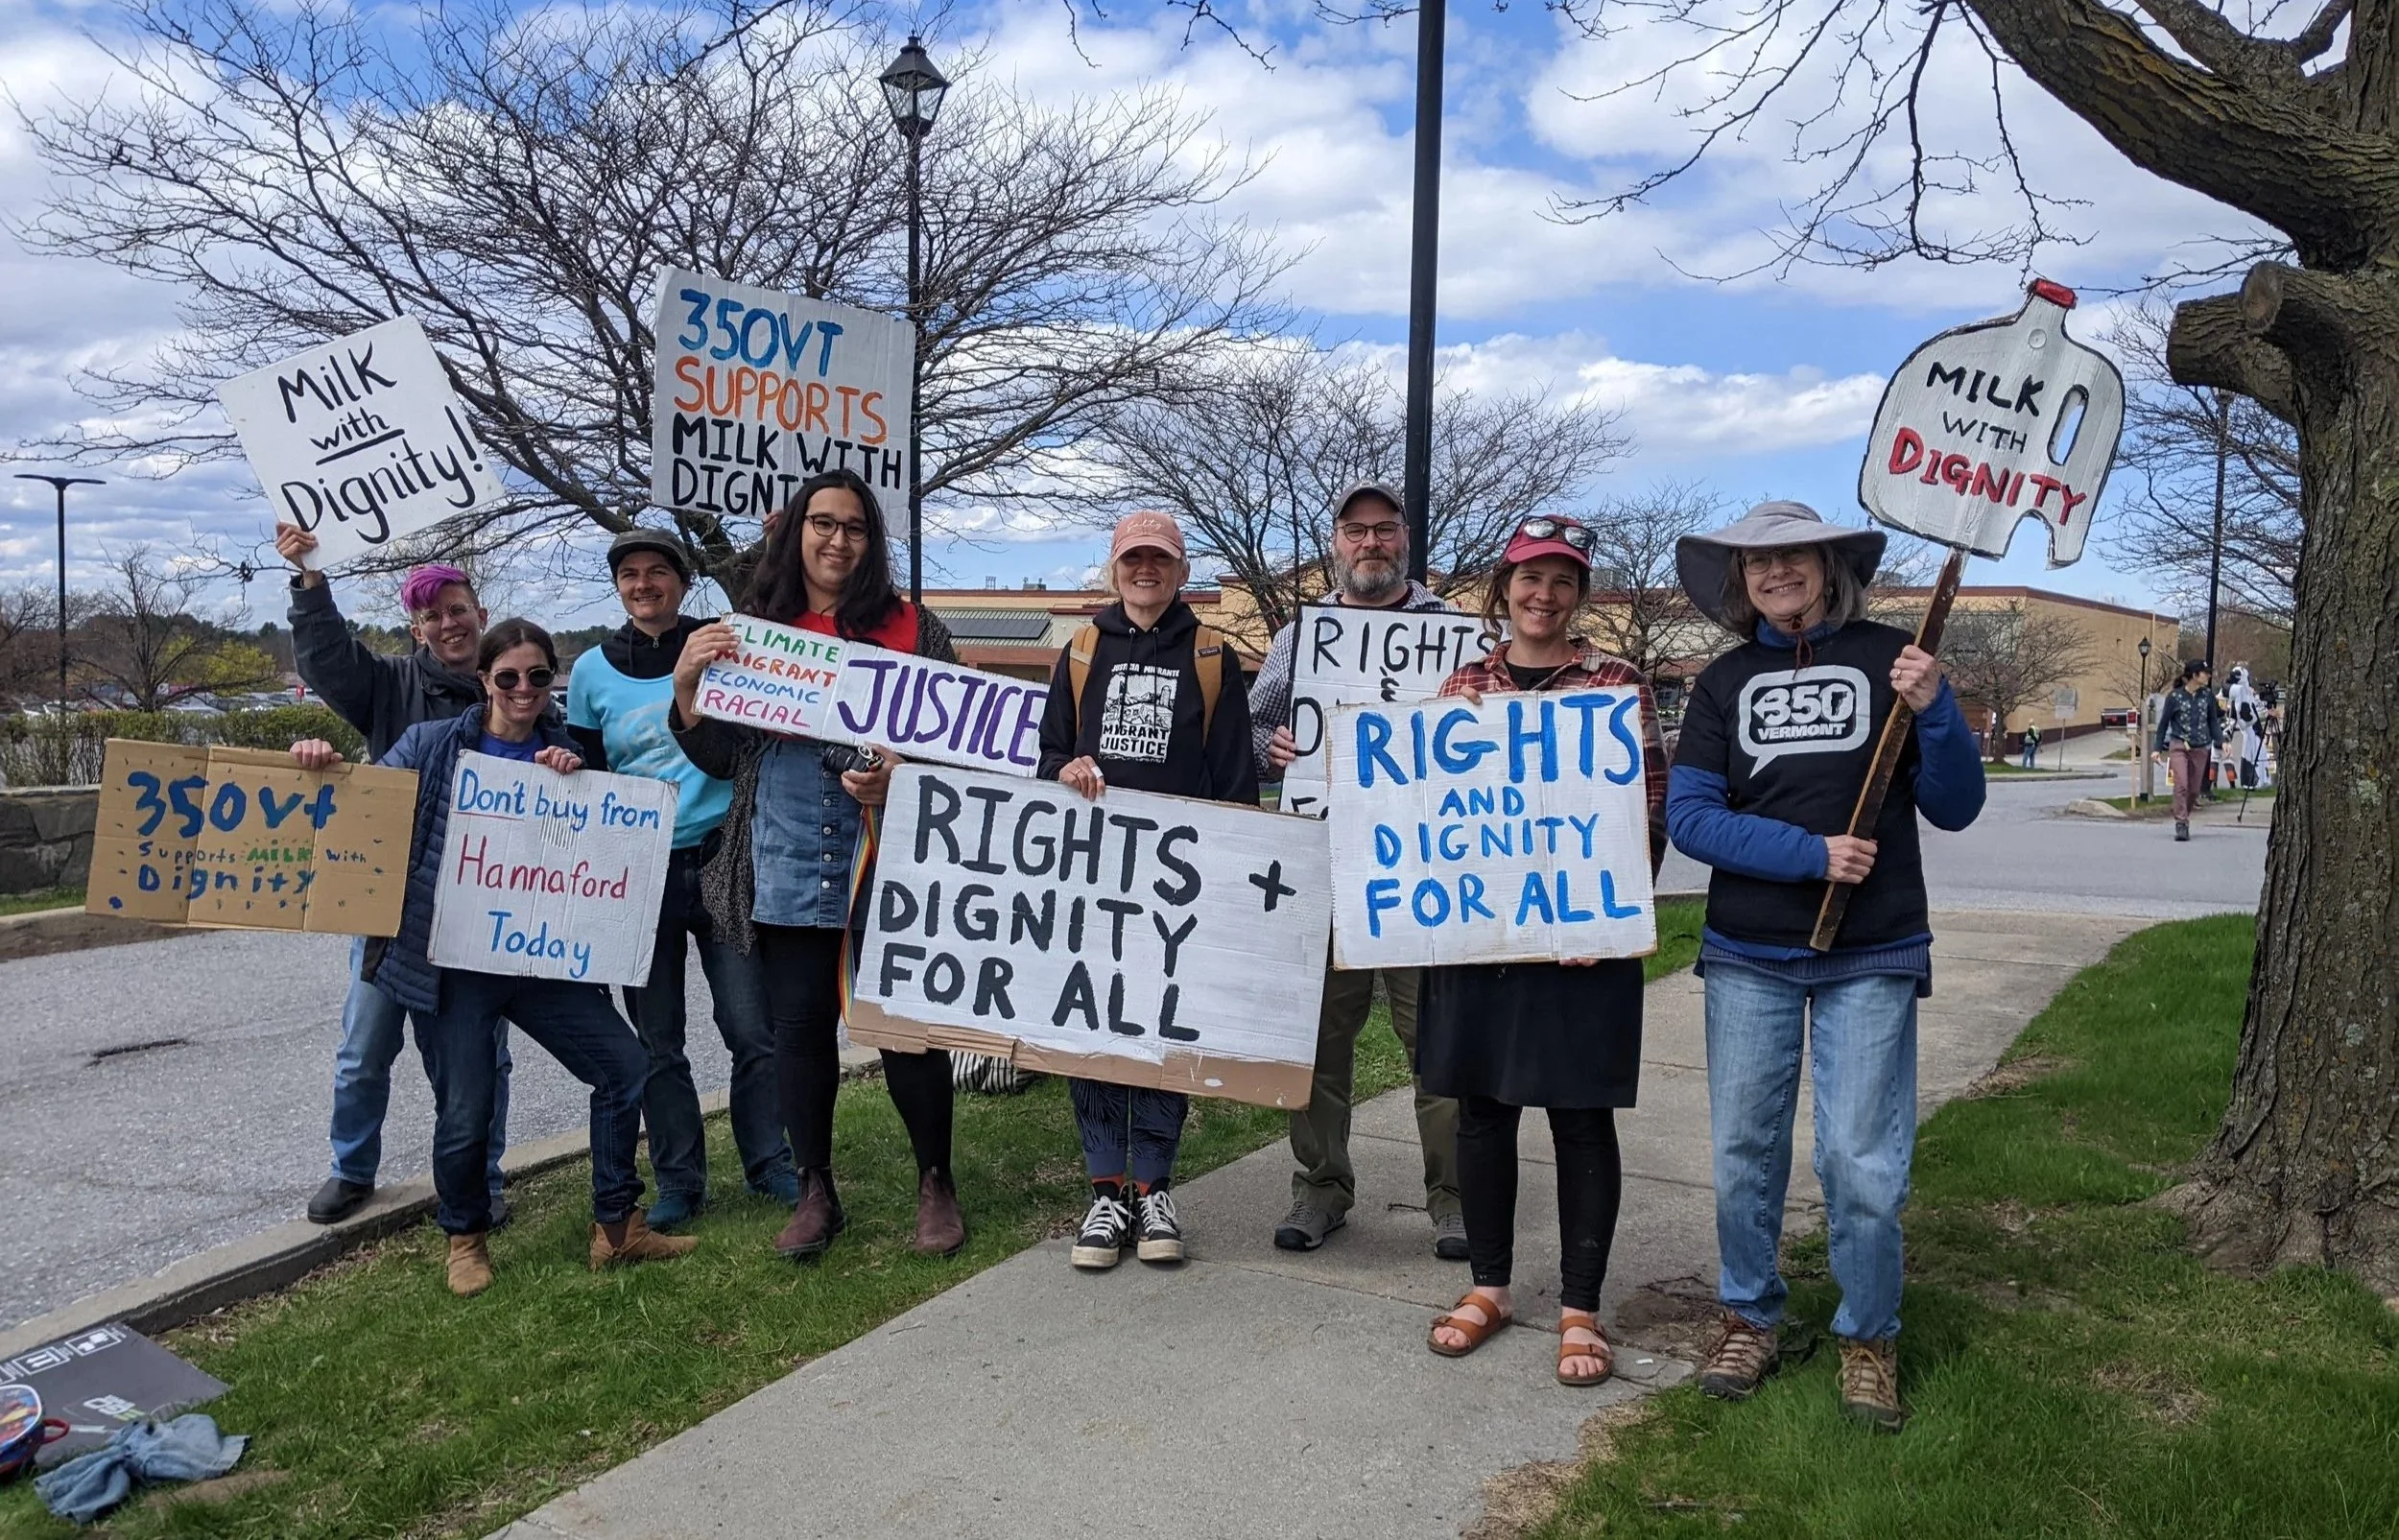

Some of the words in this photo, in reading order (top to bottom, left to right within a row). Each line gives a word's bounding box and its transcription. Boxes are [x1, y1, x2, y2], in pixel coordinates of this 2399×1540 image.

[678, 288, 843, 377] 350VT
[674, 355, 888, 445] SUPPORTS
[1927, 362, 2045, 417] MILK
[309, 406, 391, 450] with
[672, 412, 779, 471] MILK
[796, 432, 902, 490] WITH
[1943, 411, 2028, 454] WITH
[281, 405, 484, 544] Dignity!
[672, 457, 816, 516] DIGNI
[1888, 427, 2087, 526] DIGNITY
[705, 667, 820, 704] ECONOMIC
[714, 650, 837, 688] MIGRANT
[703, 689, 811, 728] RACIAL
[837, 659, 1048, 766] JUSTICE
[1103, 723, 1170, 740] MIGRANT
[1751, 683, 1854, 726] 350
[1757, 723, 1846, 741] VERMONT
[1101, 737, 1168, 756] JUSTICE
[1356, 694, 1640, 788] RIGHTS
[457, 768, 526, 815] Don't
[534, 784, 588, 832] buy
[601, 792, 659, 830] from
[1438, 785, 1525, 817] AND
[138, 841, 236, 864] Supports
[457, 833, 629, 899] Hannaford
[914, 774, 1201, 907] RIGHTS
[1248, 860, 1297, 912] +
[1374, 813, 1600, 869] DIGNITY
[138, 864, 317, 899] Dignity
[1366, 872, 1495, 937] FOR
[1515, 869, 1642, 926] ALL
[488, 911, 591, 979] Today
[879, 879, 1198, 978] DIGNITY
[879, 942, 1015, 1020] FOR
[1052, 960, 1200, 1042] ALL
